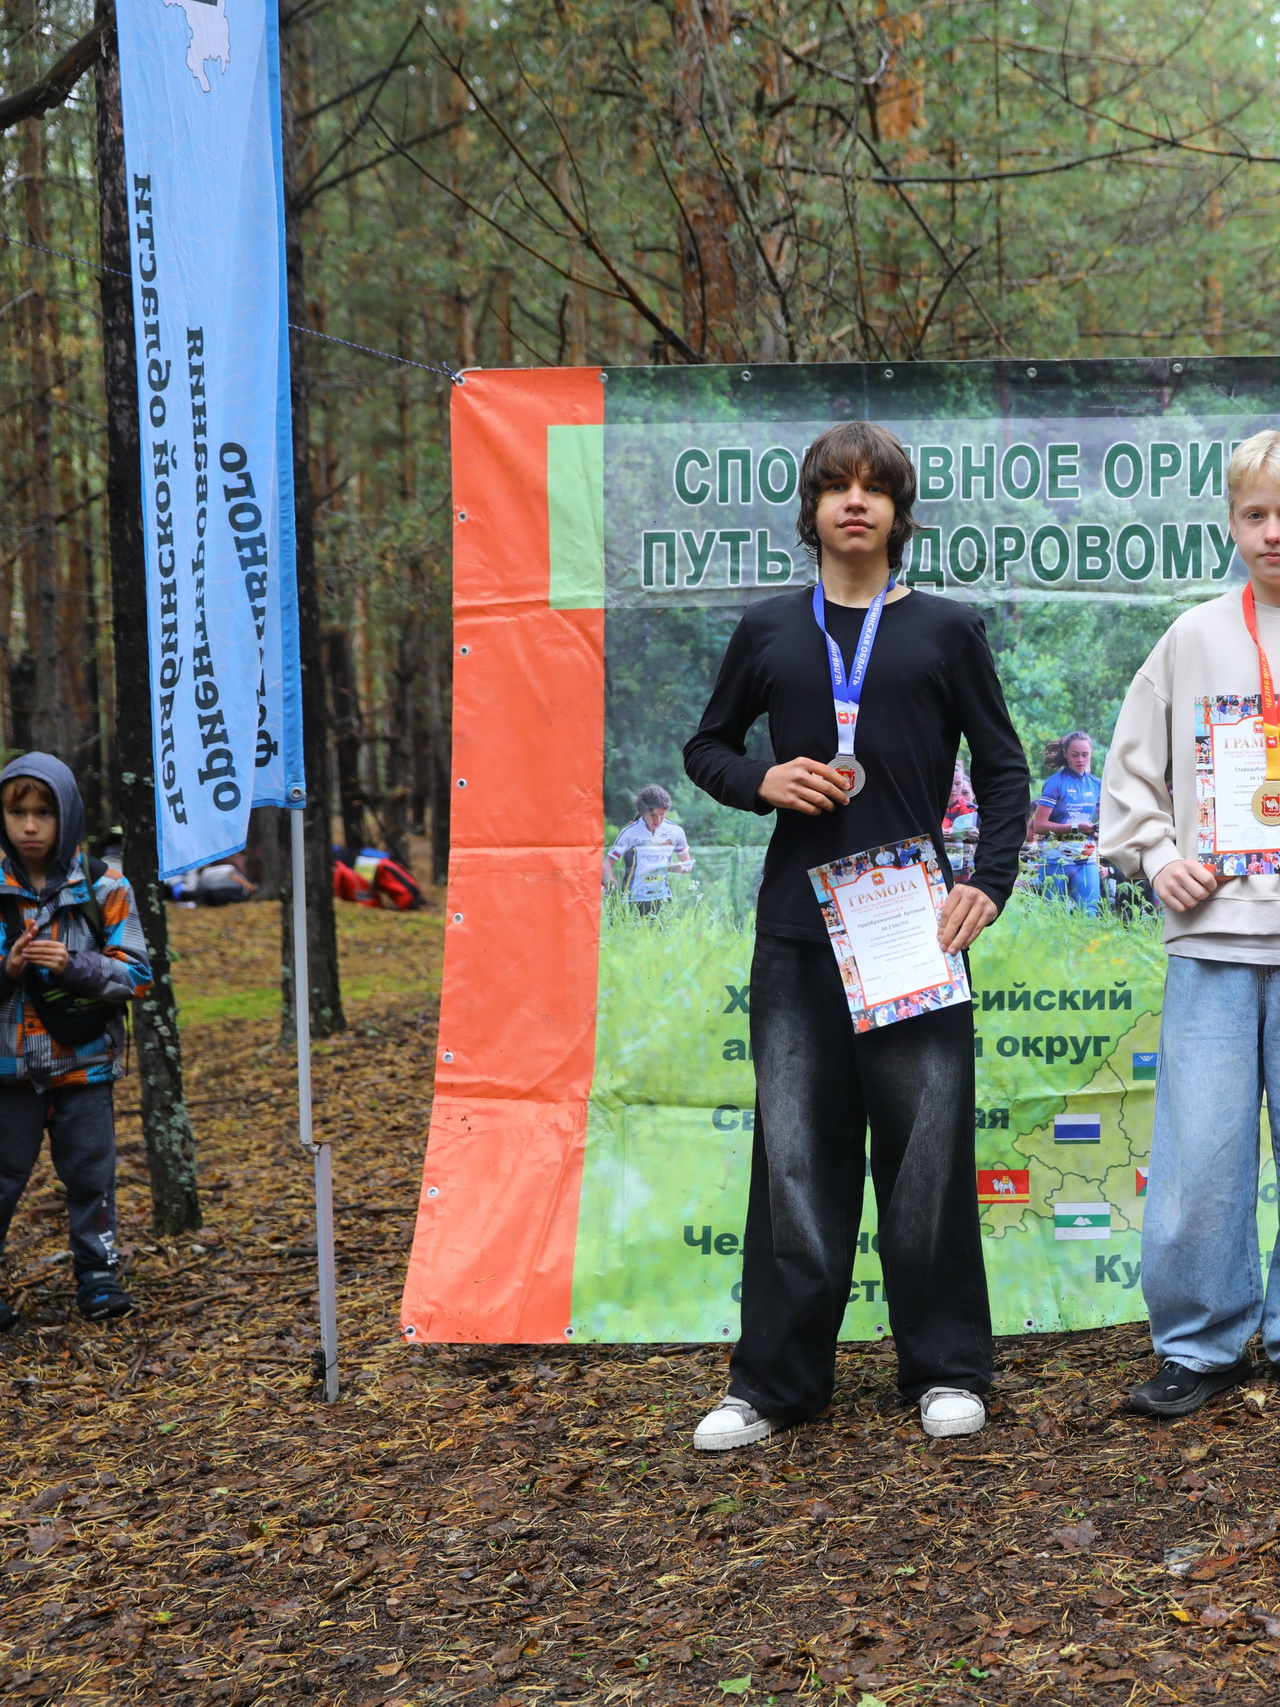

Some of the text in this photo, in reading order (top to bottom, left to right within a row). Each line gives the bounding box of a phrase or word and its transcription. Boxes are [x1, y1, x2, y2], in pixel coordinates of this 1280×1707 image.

[674, 443, 1081, 505] СПОВНОЕ
[642, 529, 794, 587] ПУТЬ
[901, 521, 1238, 593] ДОРОВОМУ
[852, 646, 869, 686] ОБЛАСТЬ
[847, 880, 918, 907] ГРАМОТА
[892, 921, 909, 929] МЕСТО
[996, 1034, 1111, 1064] округ
